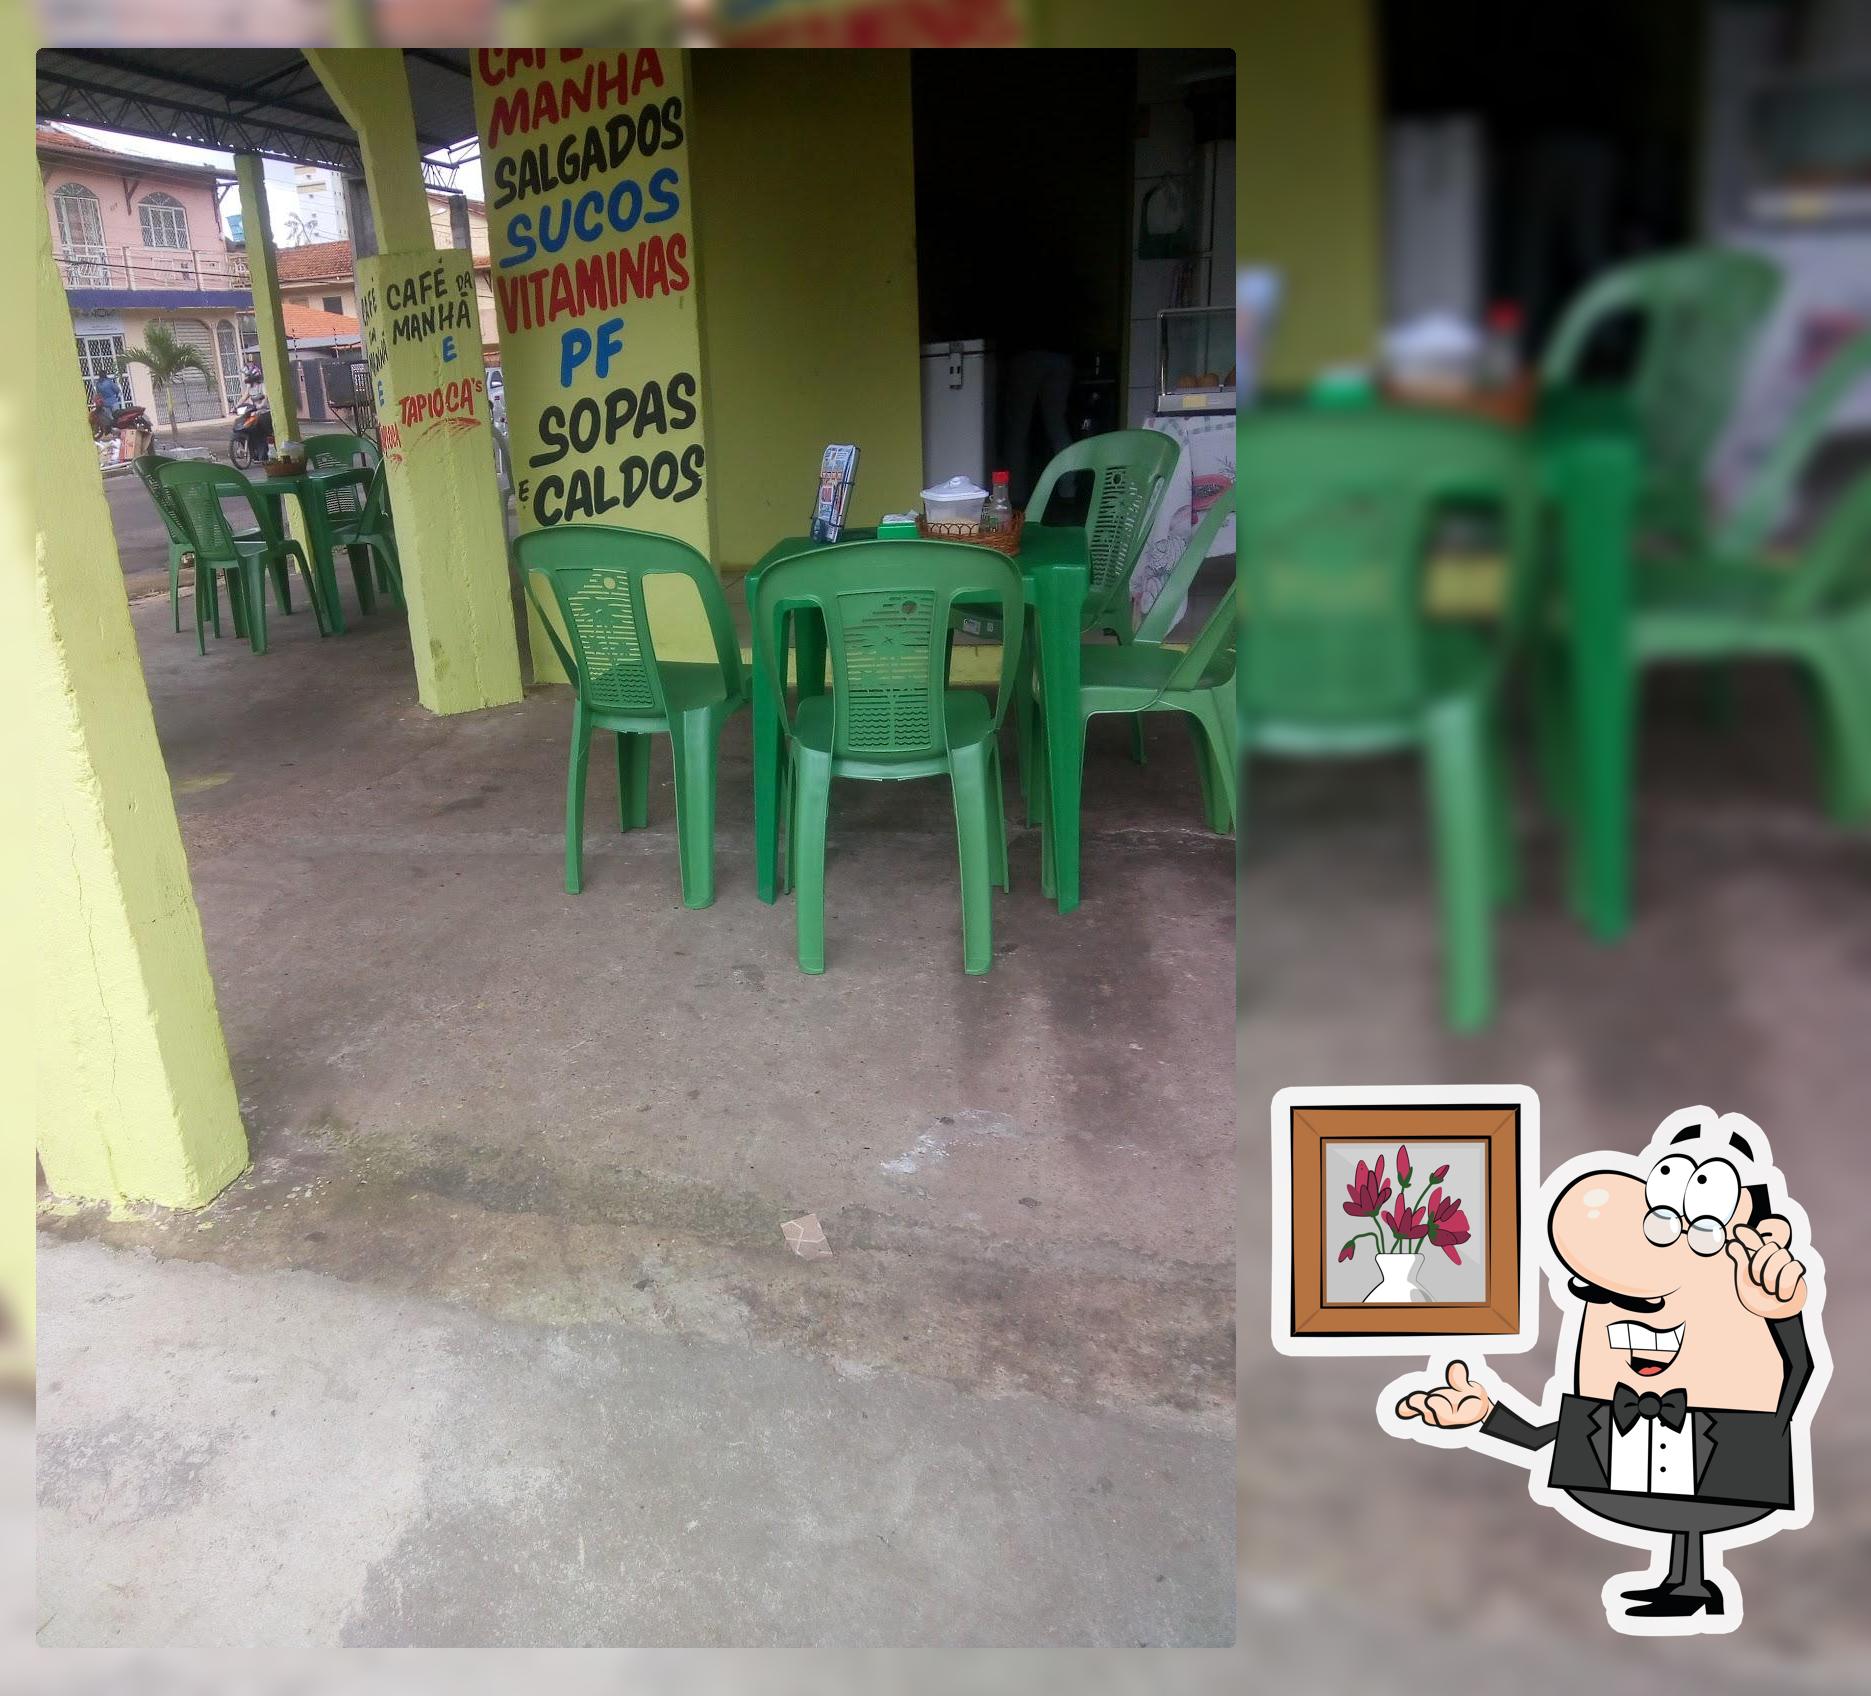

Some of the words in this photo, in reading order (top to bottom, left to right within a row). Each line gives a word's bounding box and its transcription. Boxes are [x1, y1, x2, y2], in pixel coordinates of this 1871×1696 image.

[494, 96, 684, 209] SALGADOS
[499, 168, 680, 268] SUCOS
[386, 258, 447, 311] CAFÉ
[455, 271, 473, 292] DA
[497, 233, 690, 334] VITAMINAS
[442, 335, 457, 363] E
[560, 317, 624, 388] PF
[529, 372, 696, 468] SOPAS
[519, 479, 530, 503] E
[533, 443, 705, 527] CALDOS
